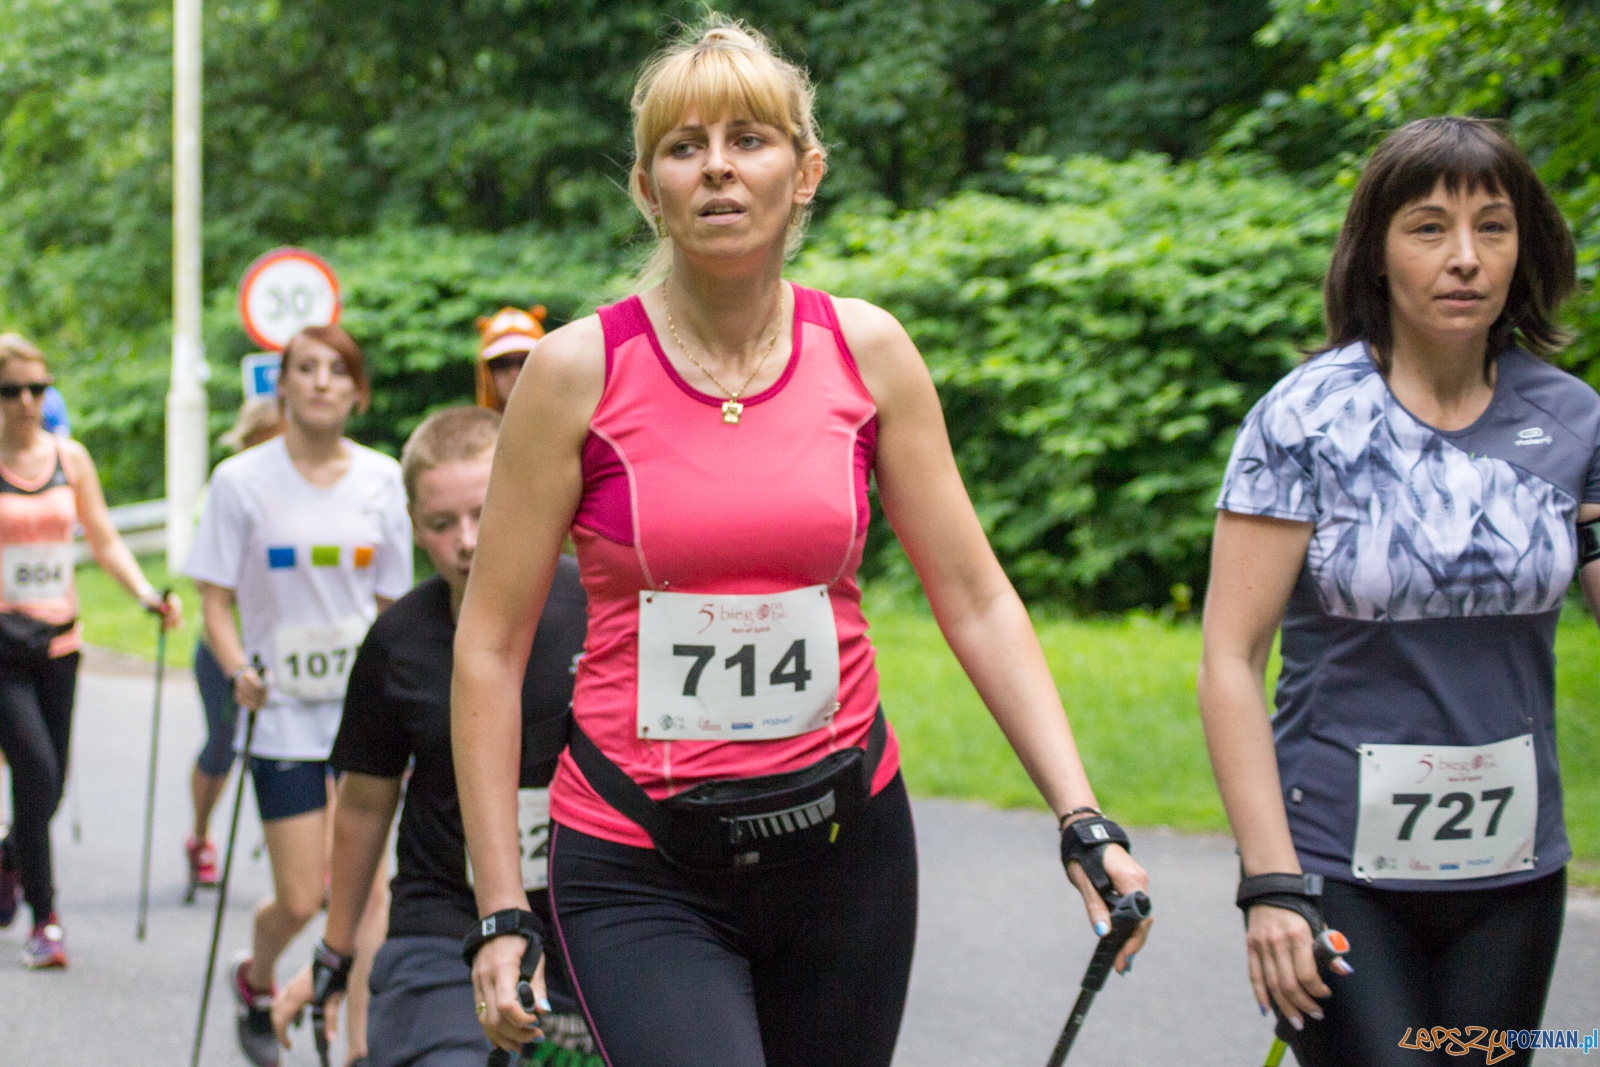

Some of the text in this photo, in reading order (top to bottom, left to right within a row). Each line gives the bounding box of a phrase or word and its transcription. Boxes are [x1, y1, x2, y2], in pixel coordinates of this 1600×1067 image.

[266, 285, 314, 322] 30
[284, 643, 361, 679] 107
[672, 639, 813, 698] 714
[1392, 786, 1516, 842] 727
